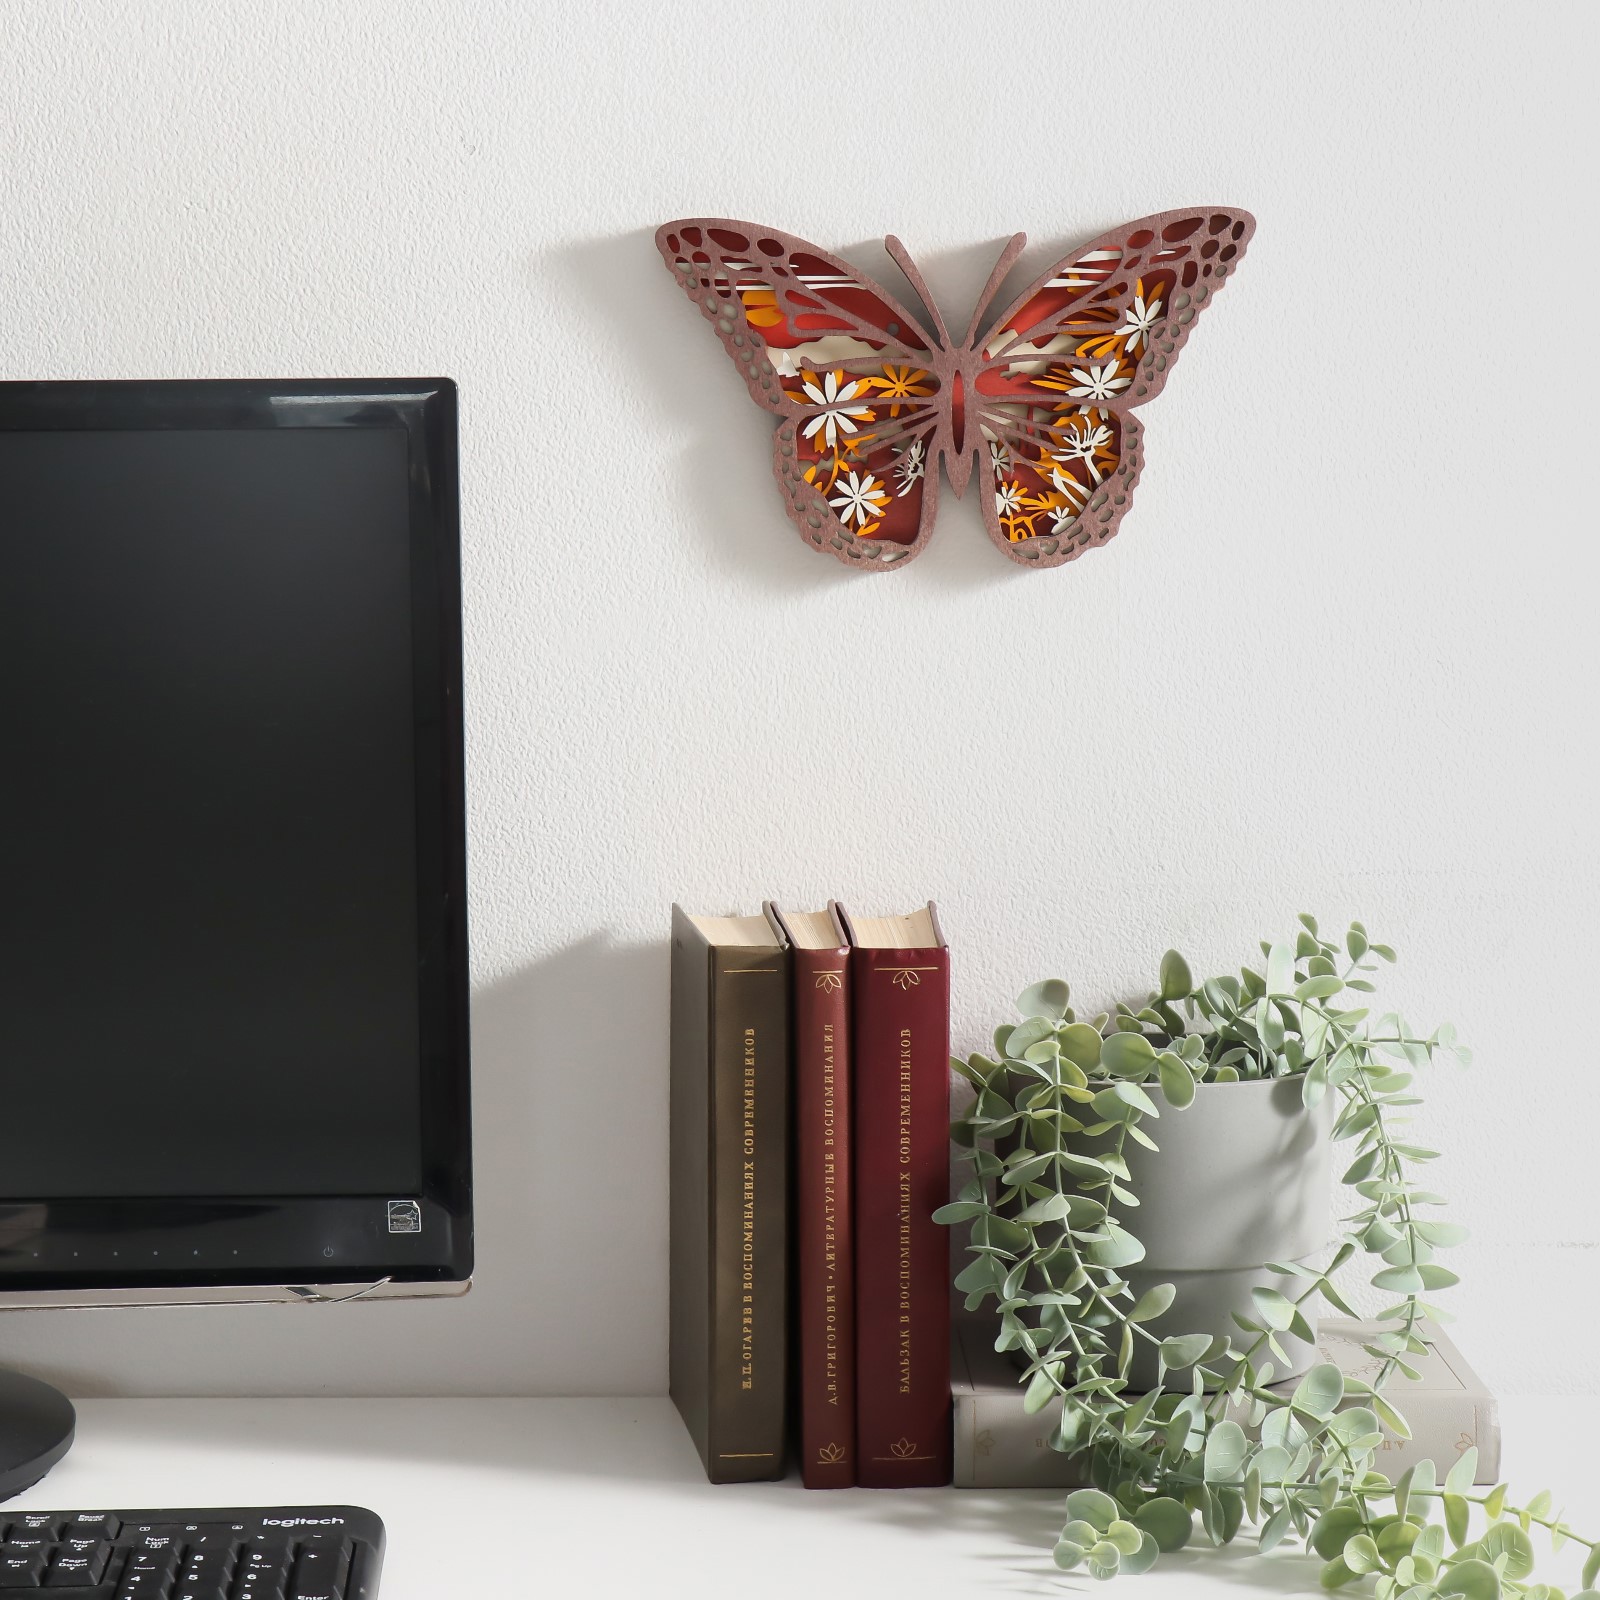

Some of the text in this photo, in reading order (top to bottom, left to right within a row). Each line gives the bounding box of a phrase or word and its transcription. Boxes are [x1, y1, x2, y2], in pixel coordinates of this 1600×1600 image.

[743, 1028, 755, 1156] СОВРЕМЕННИКОВ
[824, 1024, 834, 1146] ВОСПОМИНАНИЯ
[743, 1161, 754, 1290] ВОСПОМИНАНИЯХ
[824, 1152, 836, 1272] ЛИТЕРАТУРНЫЕ
[899, 1028, 911, 1394] БАЛЬЗАК В ВОСПОМИНАНИЯХ СОВРЕМЕННИКОВ
[742, 1307, 753, 1360] ОГАРЕВ
[743, 1295, 753, 1303] В
[262, 1518, 345, 1527] logitech
